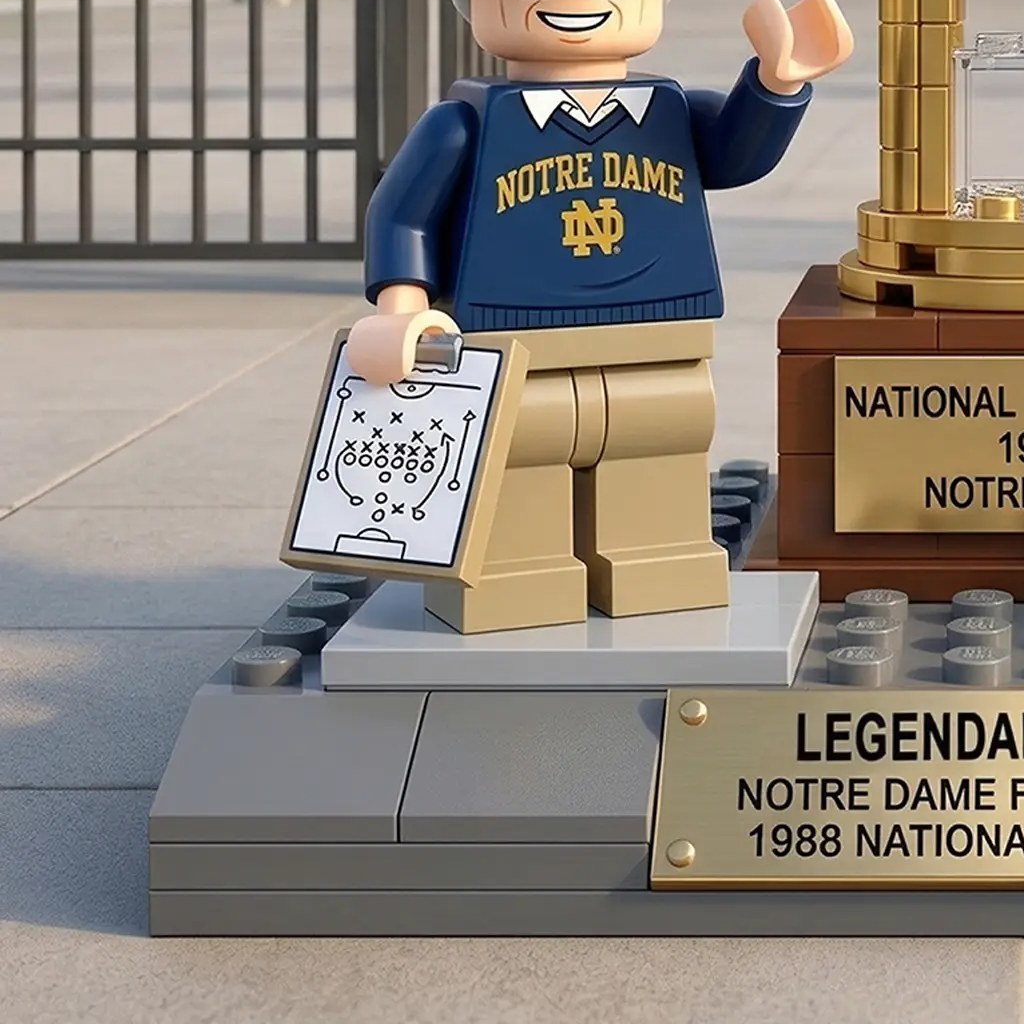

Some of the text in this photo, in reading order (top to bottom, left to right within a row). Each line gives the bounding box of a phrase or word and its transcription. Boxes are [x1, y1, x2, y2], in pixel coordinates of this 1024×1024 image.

[496, 151, 686, 213] NOTRE DAME
[845, 385, 1016, 419] NATIONAL
[738, 777, 870, 811] NOTRE
[884, 777, 997, 811] DAME
[749, 824, 842, 858] 1988
